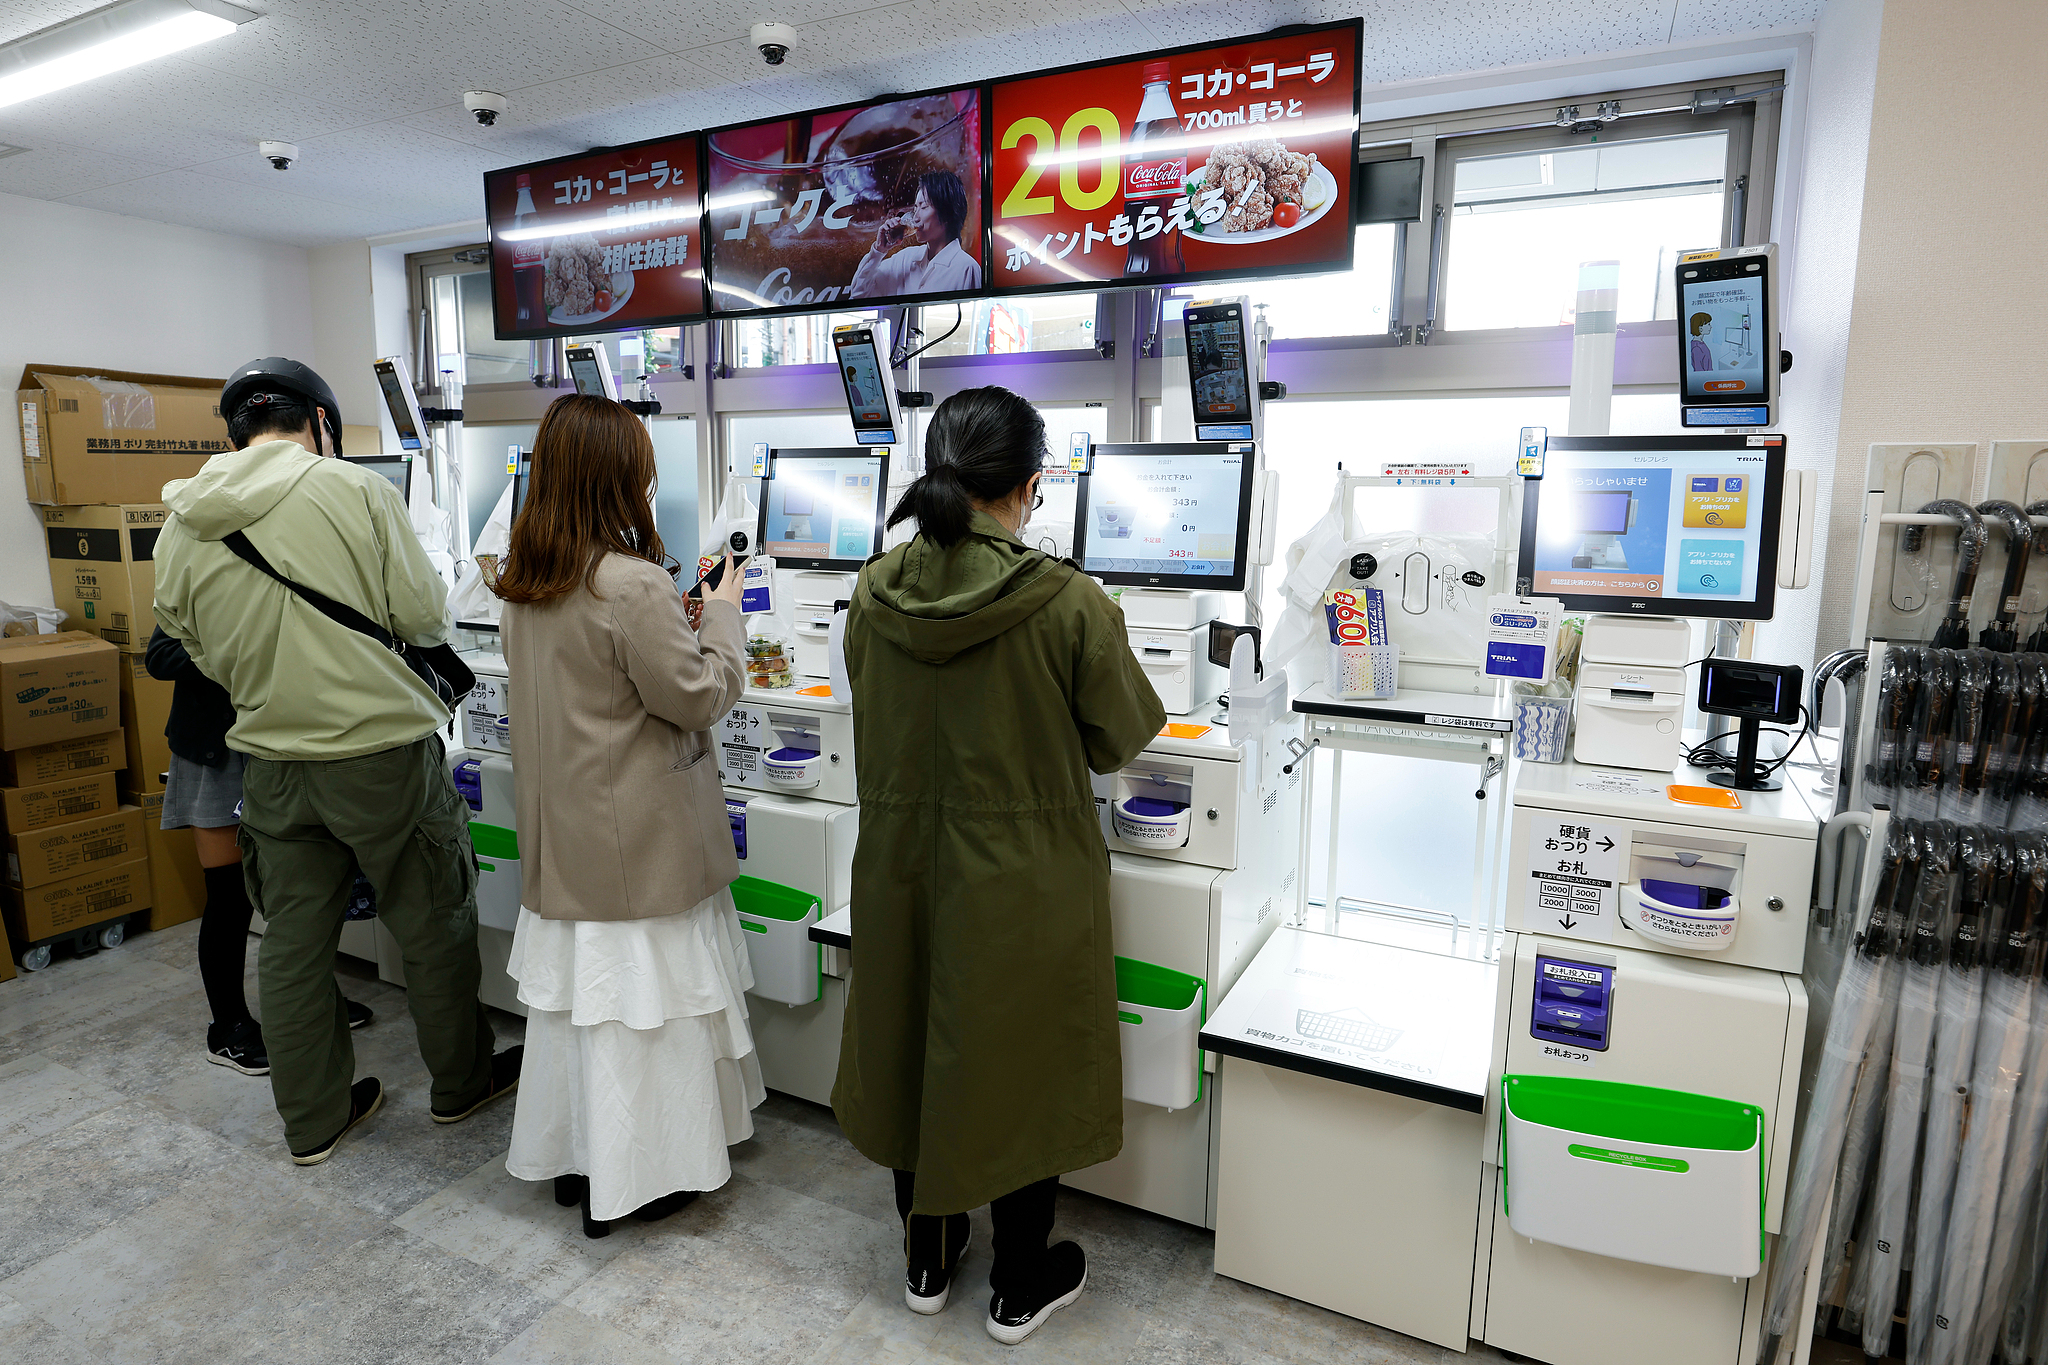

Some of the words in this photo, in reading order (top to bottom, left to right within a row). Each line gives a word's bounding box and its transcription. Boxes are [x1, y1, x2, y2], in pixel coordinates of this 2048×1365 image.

[1180, 52, 1335, 100] コカ・コーラ
[1000, 107, 1121, 218] 20
[1130, 161, 1183, 184] Coca-Cola
[554, 160, 684, 205] コカ・コーラと
[724, 186, 857, 241] コークと
[602, 235, 688, 274] 相性抜群
[86, 438, 120, 449] 業務用
[124, 439, 142, 449] ポリ
[145, 439, 198, 450] 完封竹丸箸
[1168, 550, 1193, 558] 343円
[1337, 606, 1367, 646] 60
[1369, 609, 1379, 646] アプリ入会
[1491, 654, 1518, 662] TRIAL
[471, 690, 486, 699] おつり
[75, 699, 86, 709] 30
[477, 703, 488, 712] お札
[732, 710, 747, 720] 硬貨
[1441, 717, 1496, 728] レジ袋は有料です
[726, 719, 747, 730] おつり
[733, 734, 748, 744] お札
[72, 829, 98, 839] ALKALINE
[101, 823, 125, 832] BATTERY
[1560, 824, 1591, 841] 硬貨
[1545, 838, 1588, 854] おつり
[1557, 860, 1588, 875] お札
[76, 881, 102, 892] ALKALINE
[105, 874, 129, 884] BATTERY
[1543, 885, 1568, 894] 10000
[1576, 889, 1596, 897] 5000
[1544, 898, 1564, 907] 2000
[1576, 903, 1594, 911] 1000
[1650, 914, 1721, 930] おつりをとるときいがい
[1652, 922, 1718, 937] さわらないでください
[1550, 966, 1596, 979] お札投入口
[1245, 1027, 1434, 1075] 買物カゴを置いてください
[1544, 1046, 1589, 1062] お札おつり
[1608, 1152, 1634, 1160] RECYCLE
